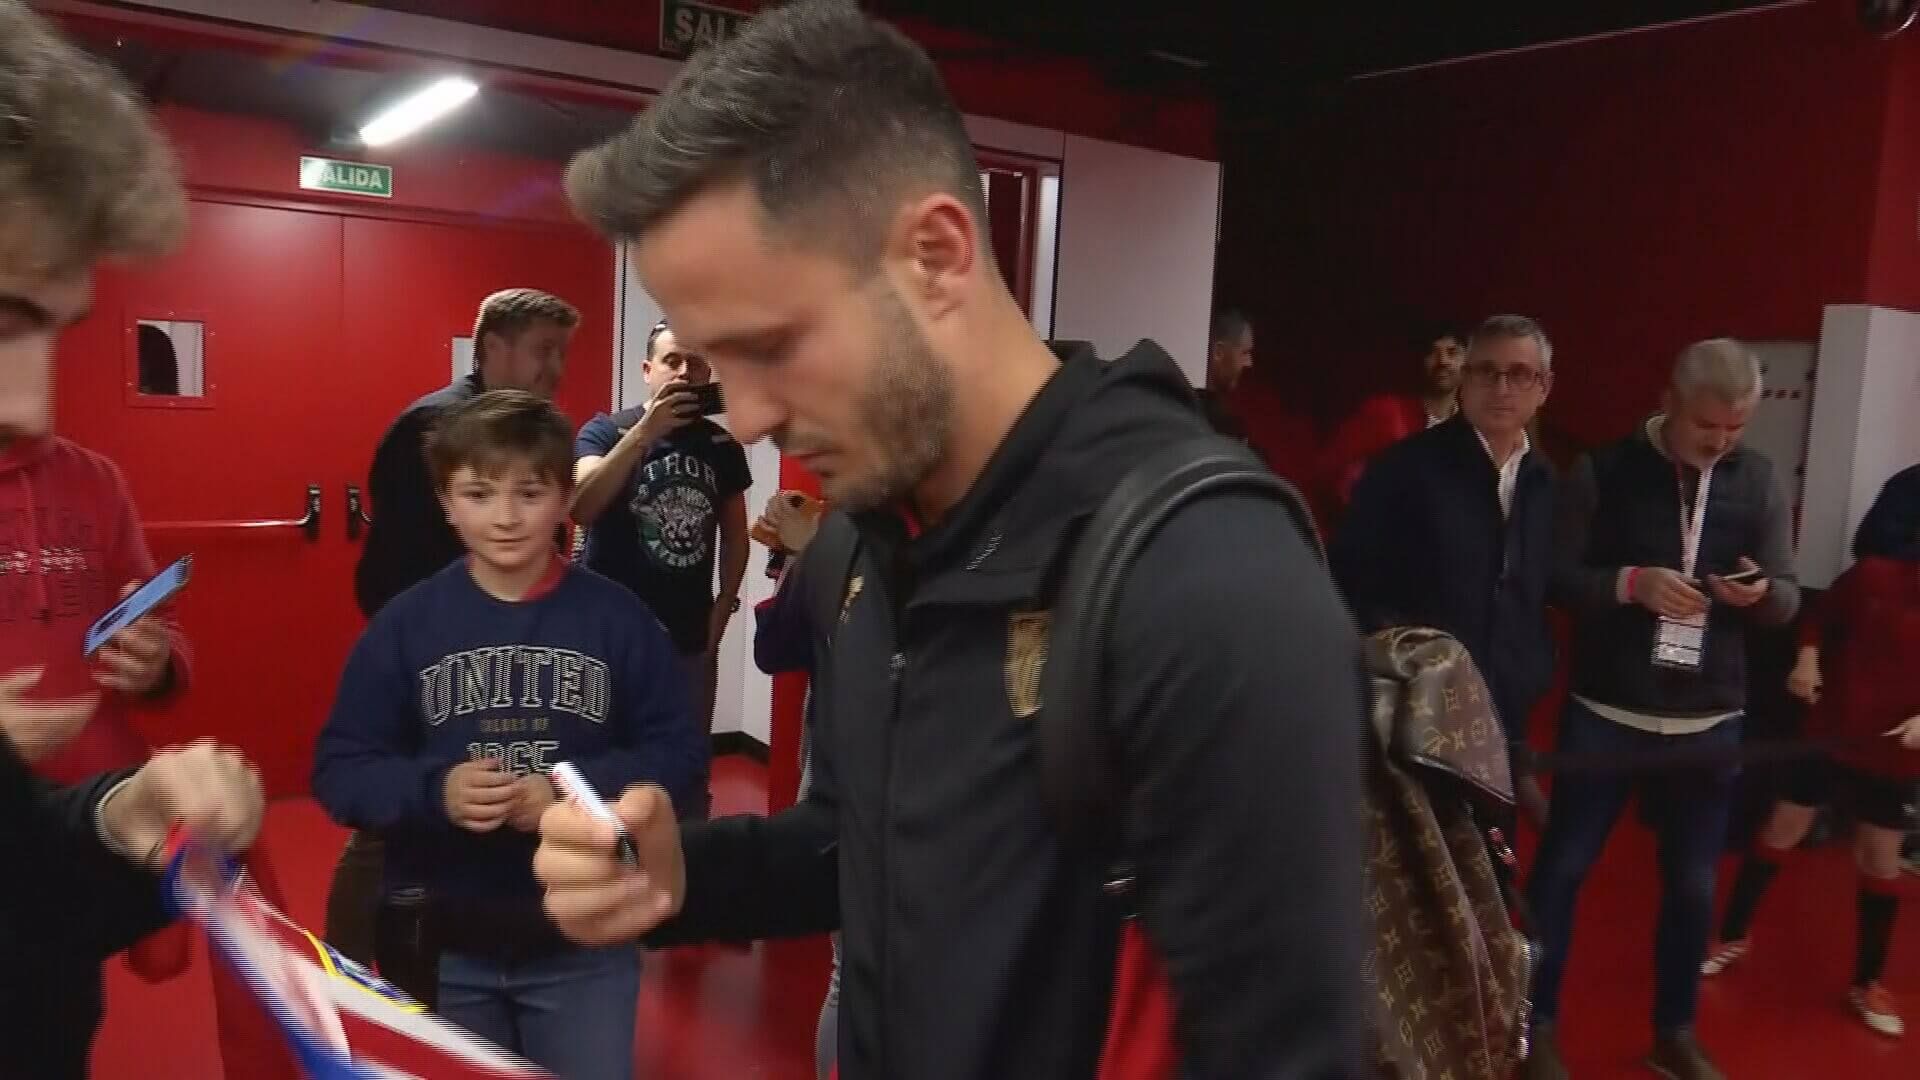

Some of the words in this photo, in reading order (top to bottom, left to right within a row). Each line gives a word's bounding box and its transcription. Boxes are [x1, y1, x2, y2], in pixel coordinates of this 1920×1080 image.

[311, 164, 383, 189] ALIDA
[644, 452, 718, 494] THOR
[419, 645, 612, 727] UNITED
